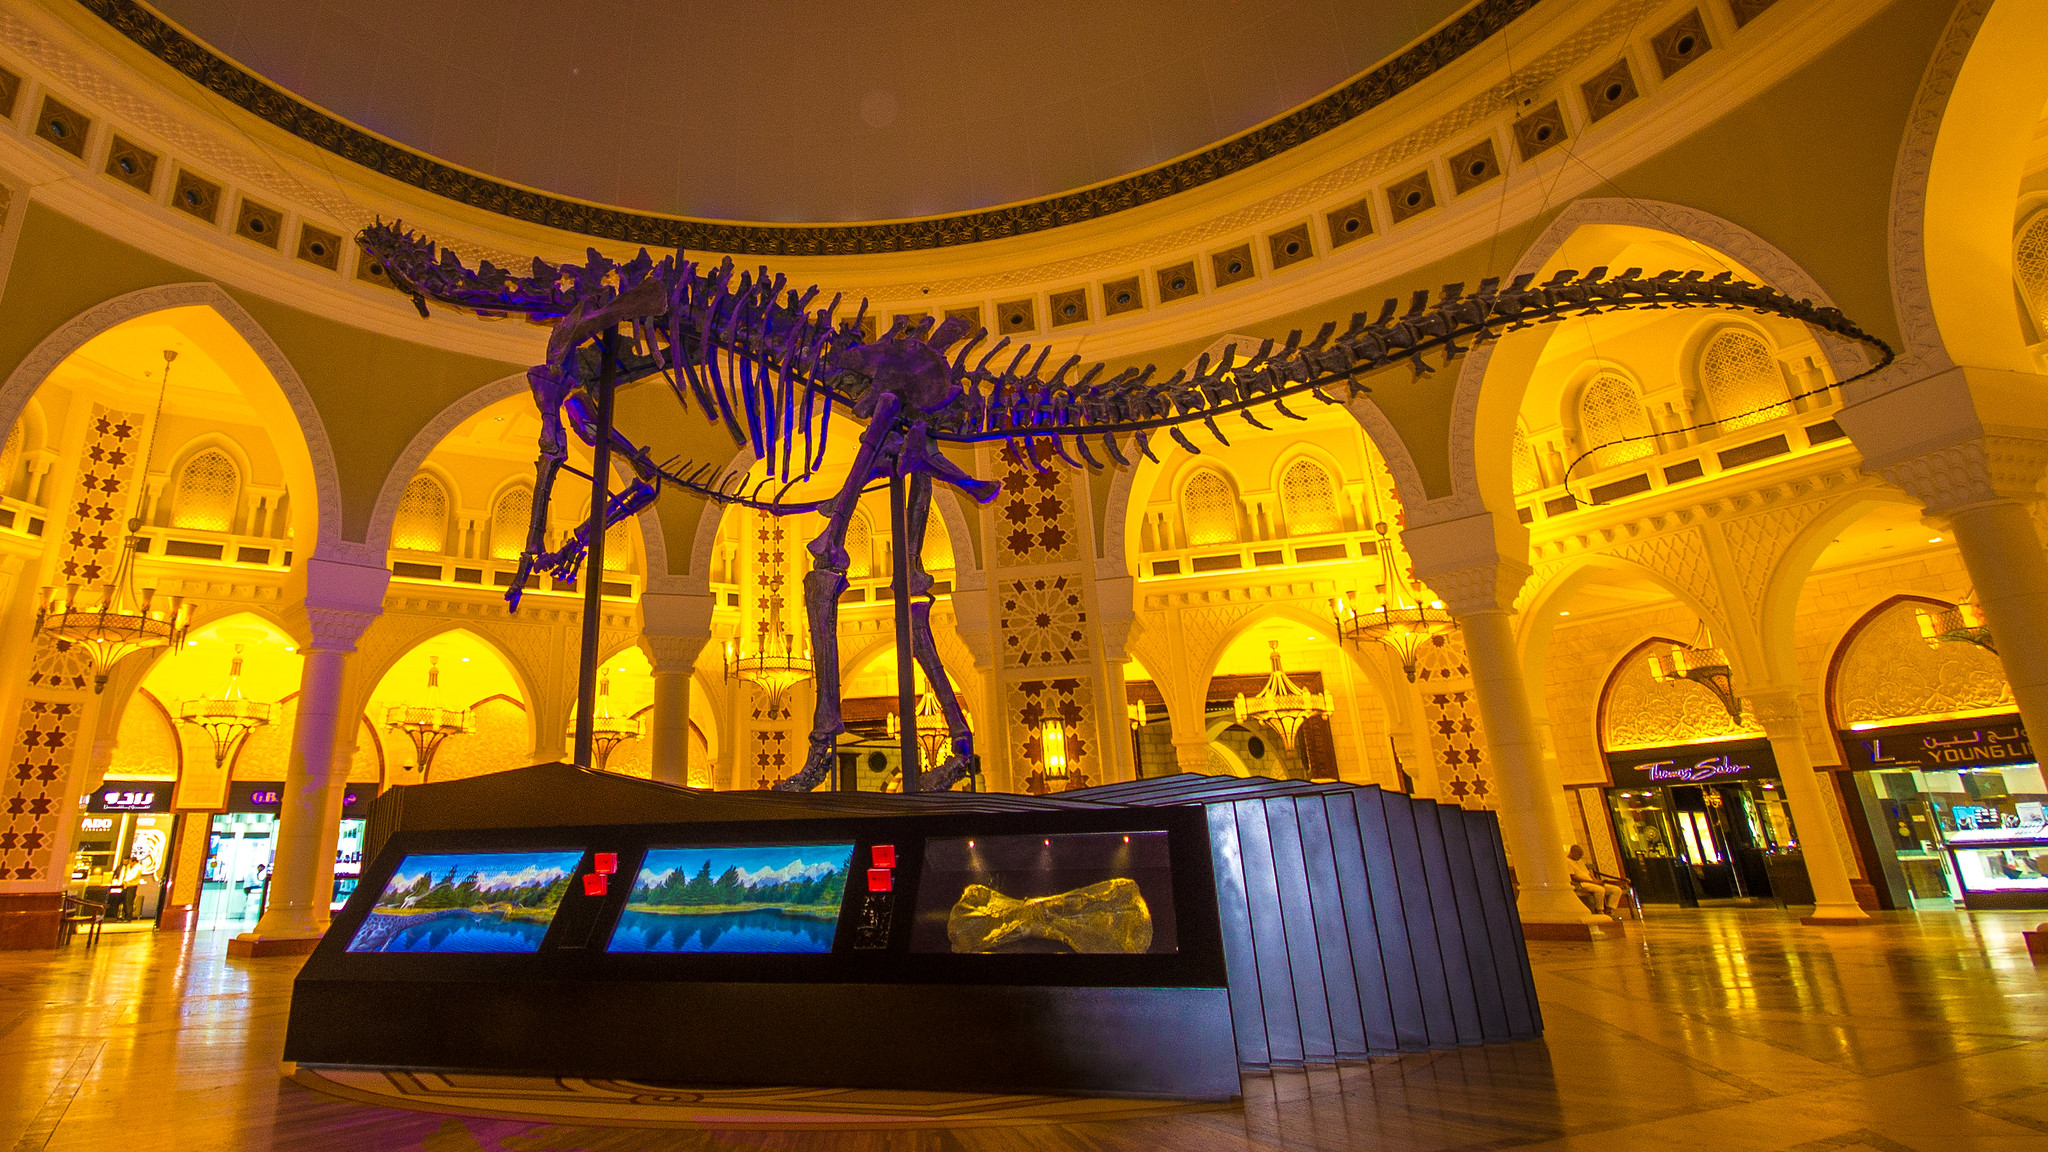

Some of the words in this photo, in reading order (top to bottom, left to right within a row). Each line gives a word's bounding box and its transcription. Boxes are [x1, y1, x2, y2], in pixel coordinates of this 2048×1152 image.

[1633, 760, 1693, 781] Thomas
[1689, 755, 1751, 781] Sabo
[81, 818, 113, 828] ADO
